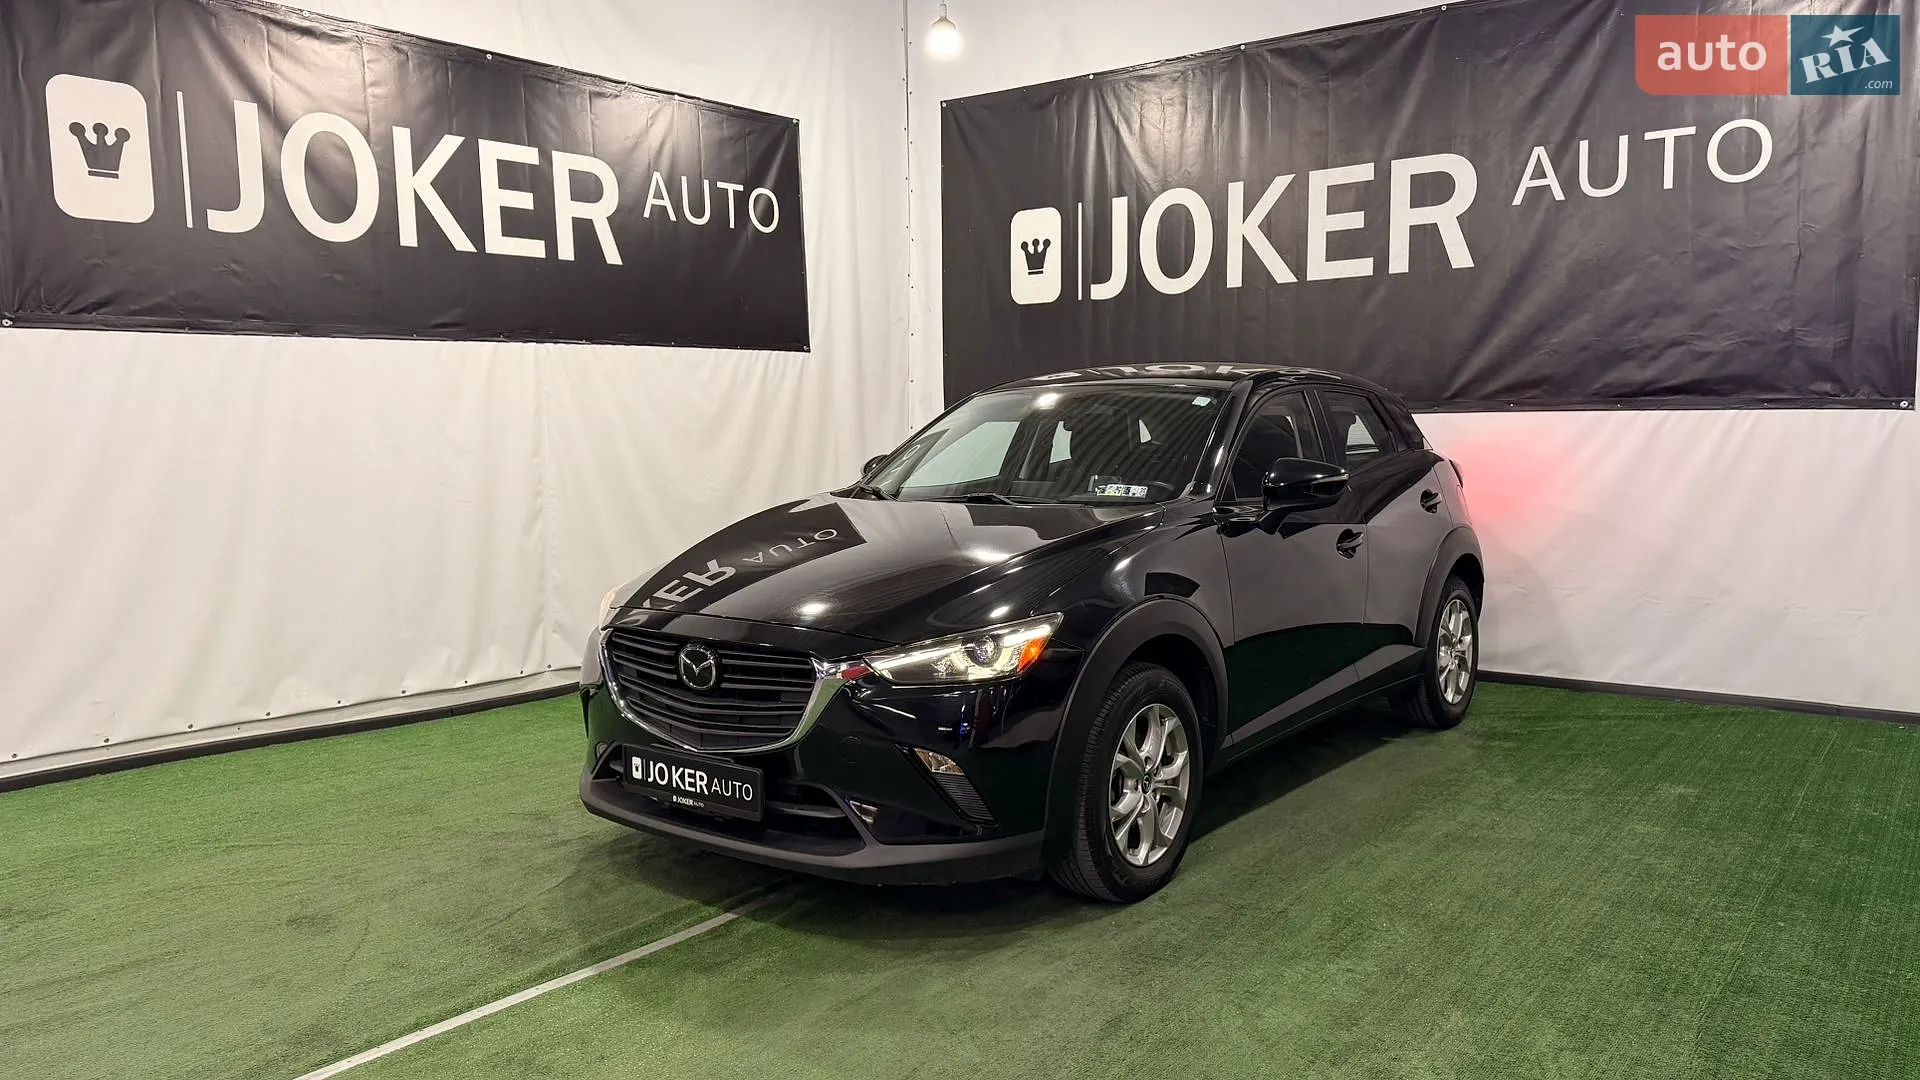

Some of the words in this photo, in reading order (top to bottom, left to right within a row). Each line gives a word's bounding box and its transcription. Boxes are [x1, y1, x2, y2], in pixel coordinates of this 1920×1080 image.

[207, 100, 623, 265] JOKER
[643, 171, 780, 234] AUTO
[1090, 153, 1478, 300] JOKER
[1512, 119, 1773, 206] AUTO
[710, 777, 753, 801] AUTO
